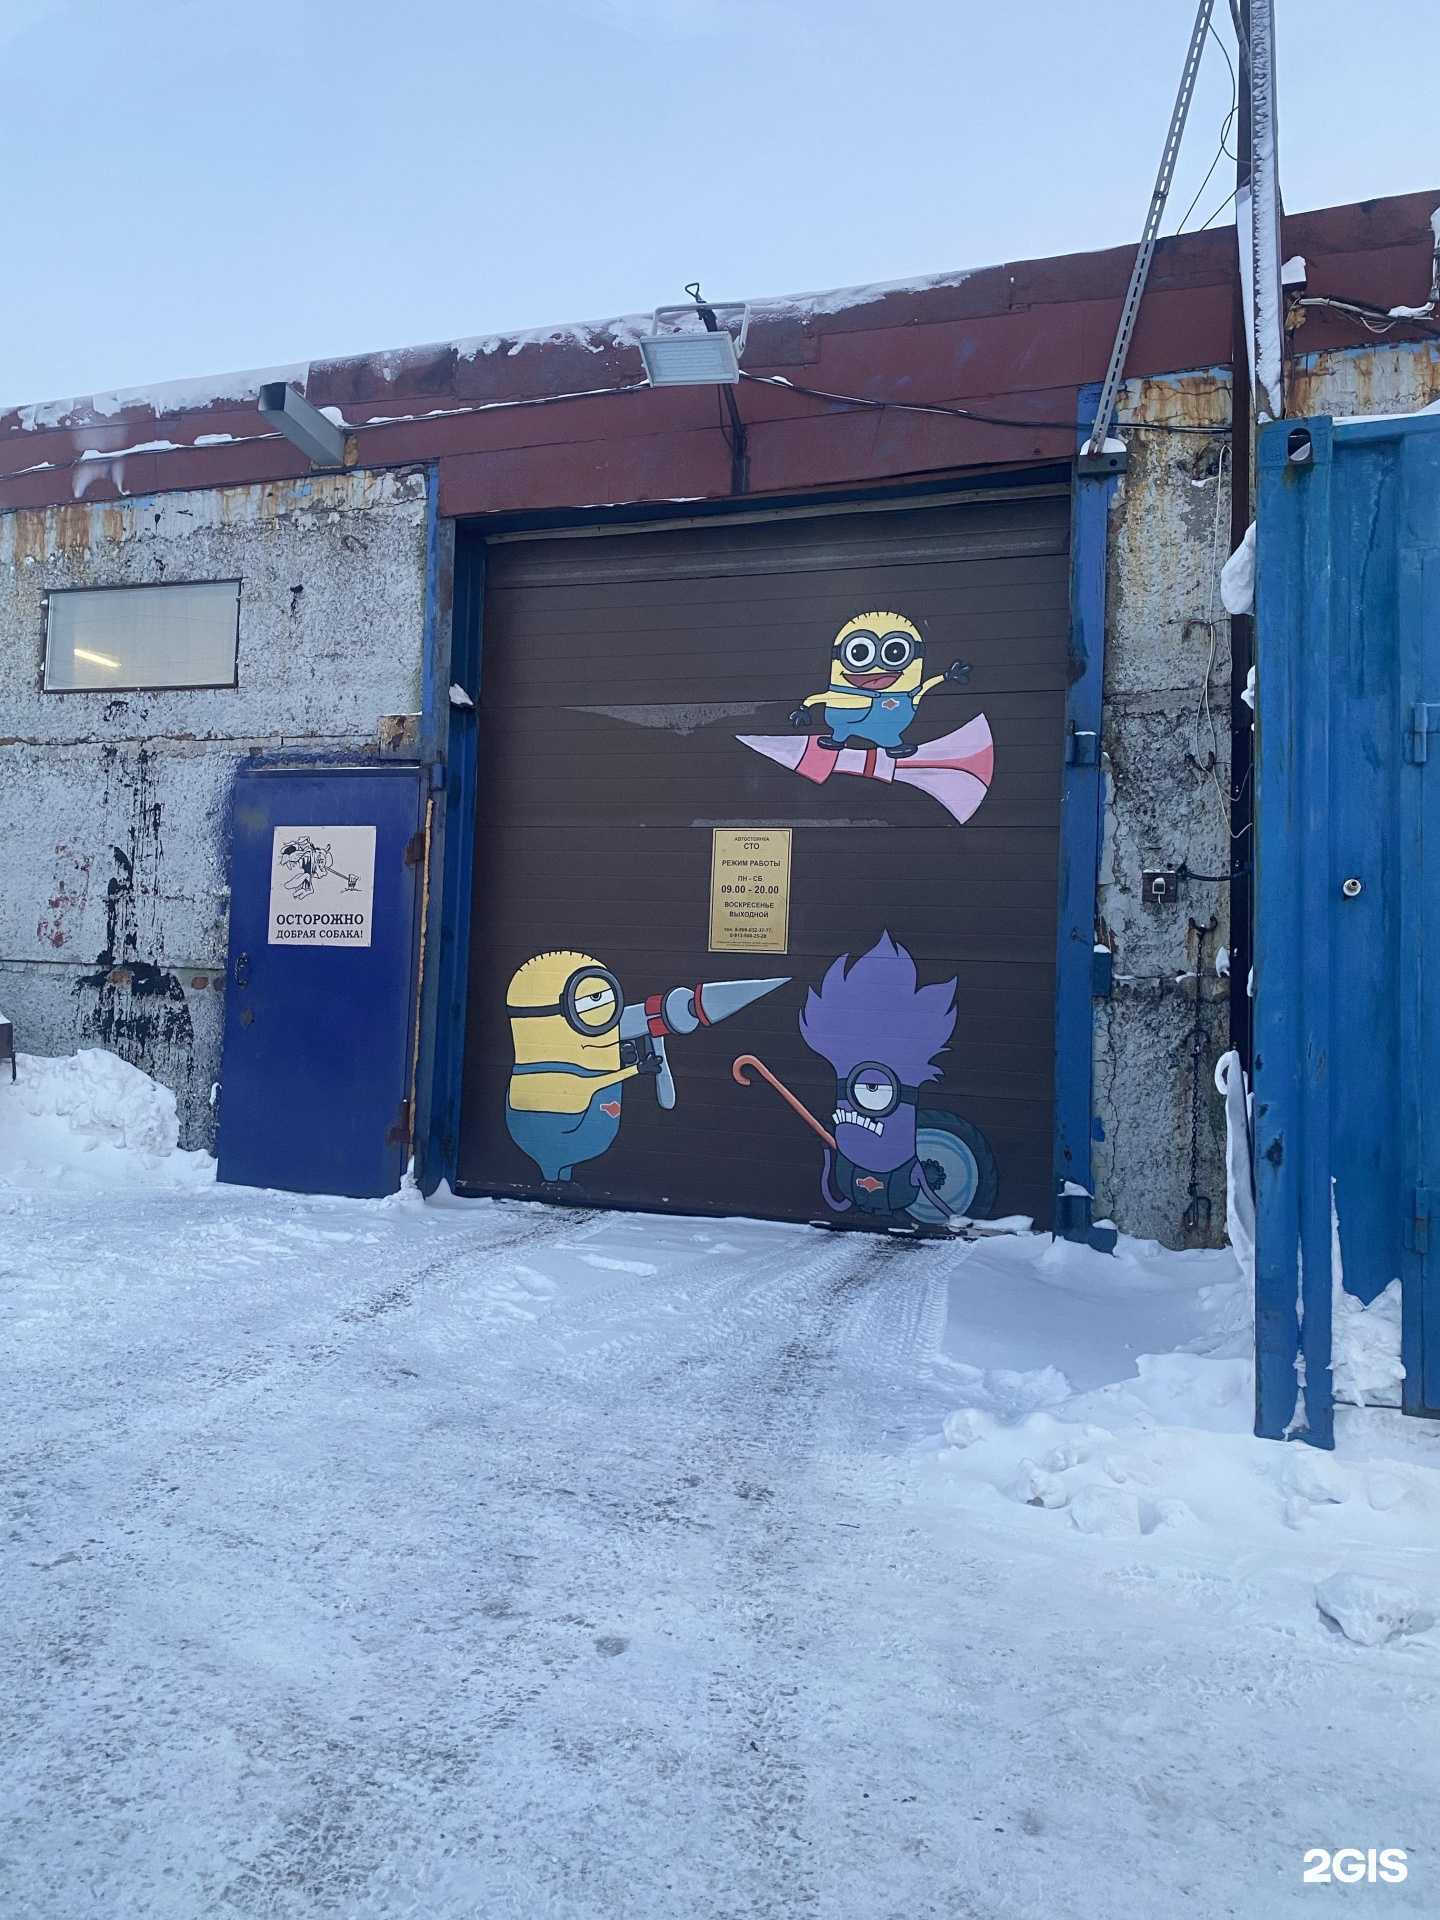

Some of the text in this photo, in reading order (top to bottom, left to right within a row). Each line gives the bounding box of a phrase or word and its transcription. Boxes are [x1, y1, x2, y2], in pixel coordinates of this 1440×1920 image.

[743, 842, 760, 850] СТО
[721, 859, 748, 867] РЕЖИМ
[721, 885, 746, 894] 09.00
[754, 885, 779, 894] 20.00
[724, 901, 775, 909] ВОСКРЕСЕНЬЕ
[276, 913, 364, 926] ОСТОРОЖНО
[276, 929, 363, 939] ДОБРАЯ СОБАКА!
